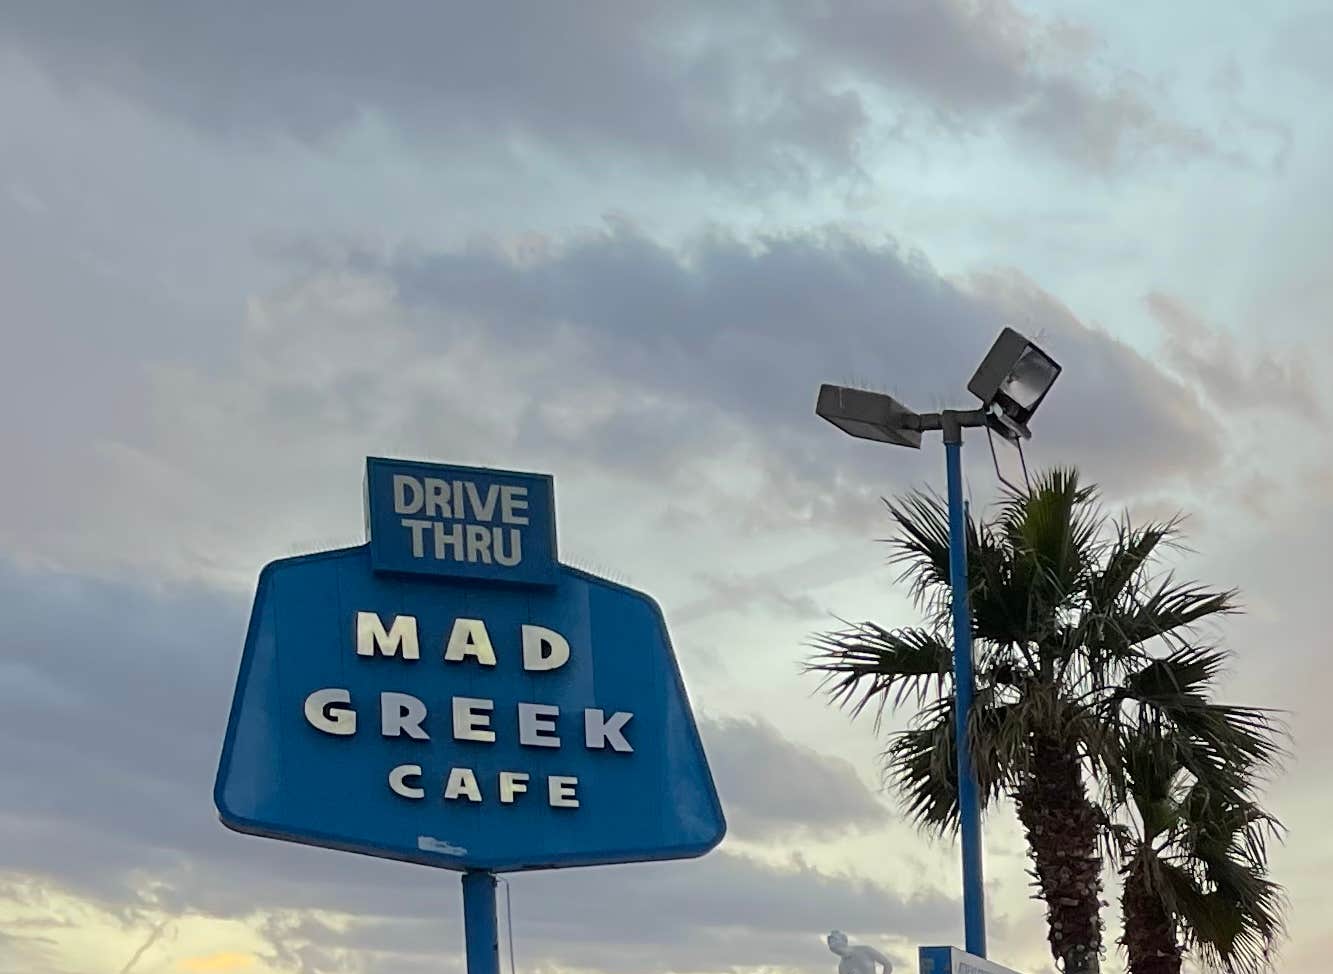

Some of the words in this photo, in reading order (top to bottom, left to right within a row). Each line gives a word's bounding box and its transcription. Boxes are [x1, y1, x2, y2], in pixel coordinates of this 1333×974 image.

[393, 475, 528, 525] DRIVE
[401, 518, 522, 566] THRU
[355, 611, 570, 671] MAD
[304, 688, 634, 752] GREEK
[388, 765, 580, 808] CAFE
